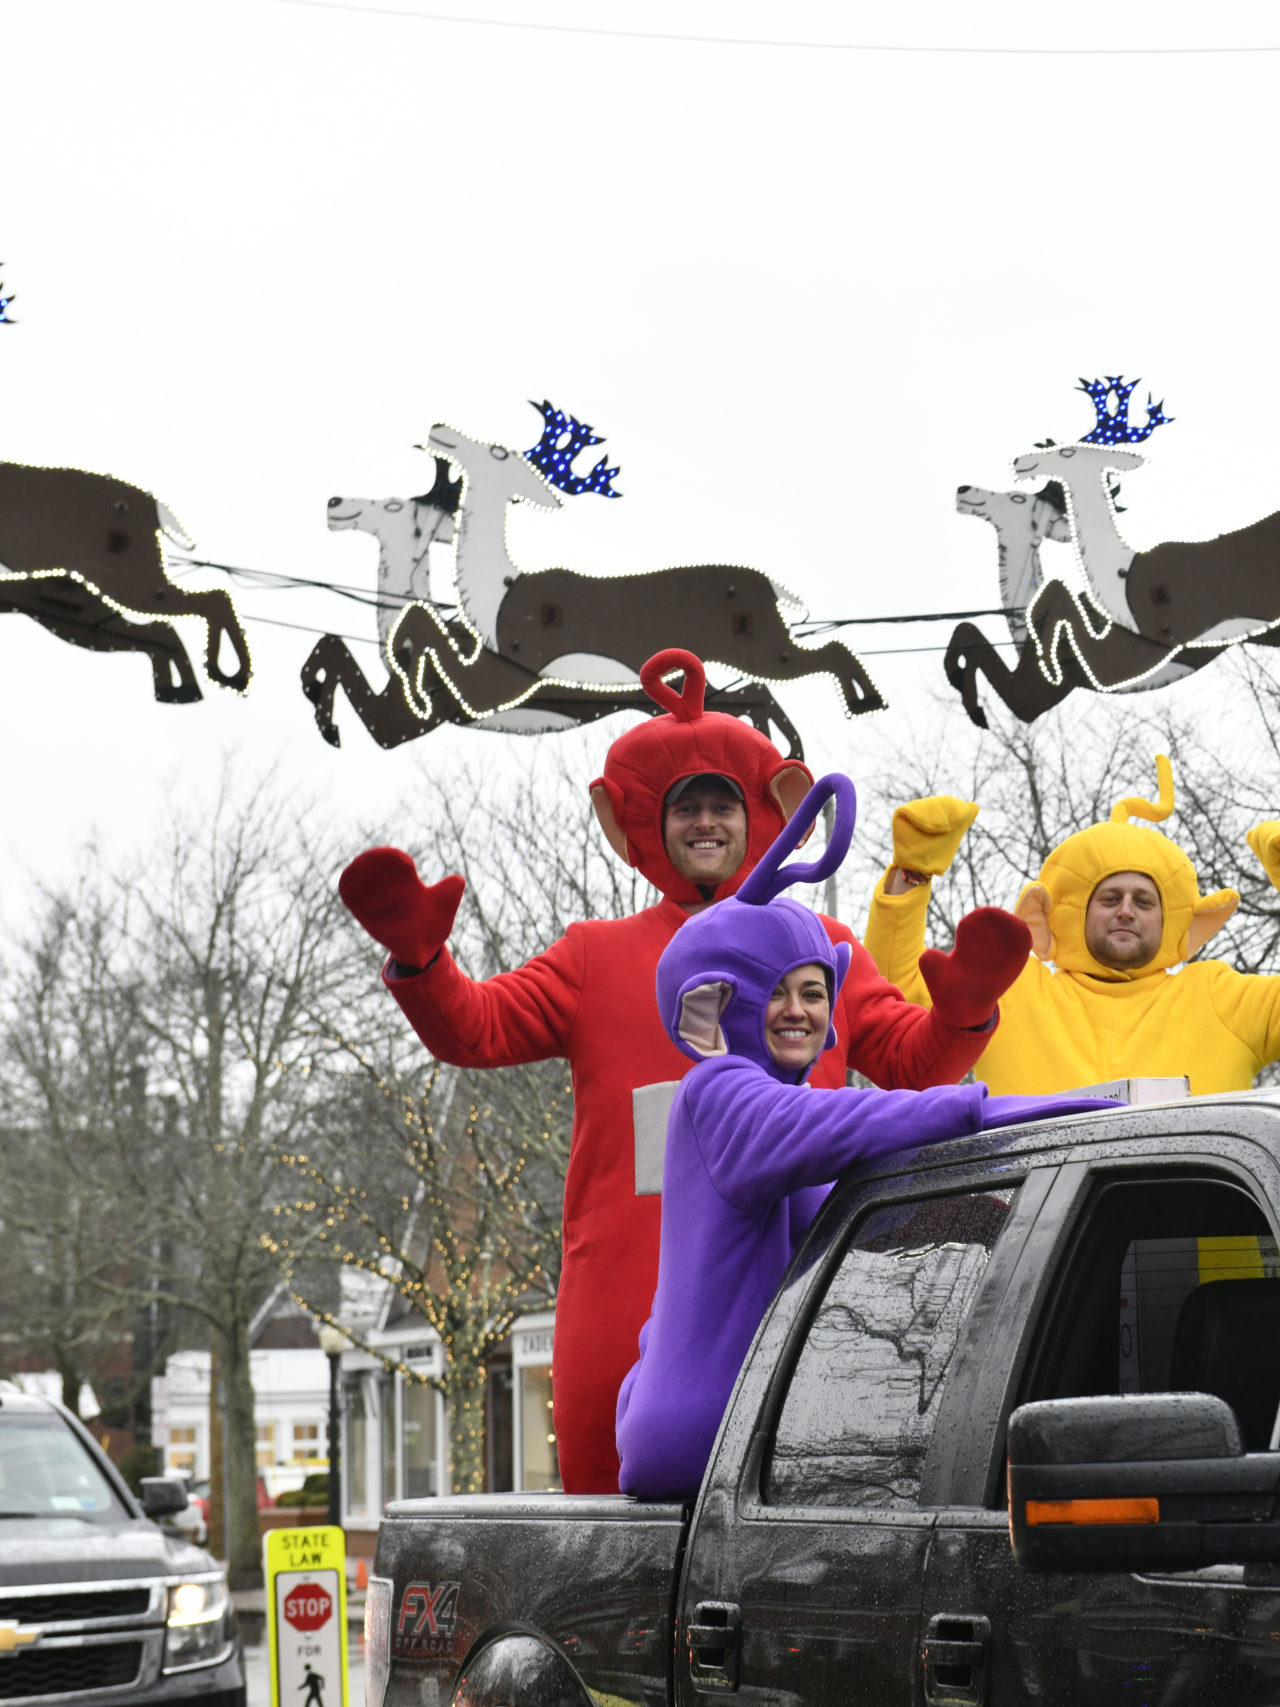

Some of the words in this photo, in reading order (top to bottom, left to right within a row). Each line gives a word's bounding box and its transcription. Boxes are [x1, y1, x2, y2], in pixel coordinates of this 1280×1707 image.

[522, 1333, 554, 1354] ZADE
[282, 1533, 330, 1549] STATE
[290, 1552, 323, 1567] LAW
[286, 1597, 331, 1619] STOP
[398, 1581, 461, 1637] FX4
[297, 1645, 322, 1657] FOR
